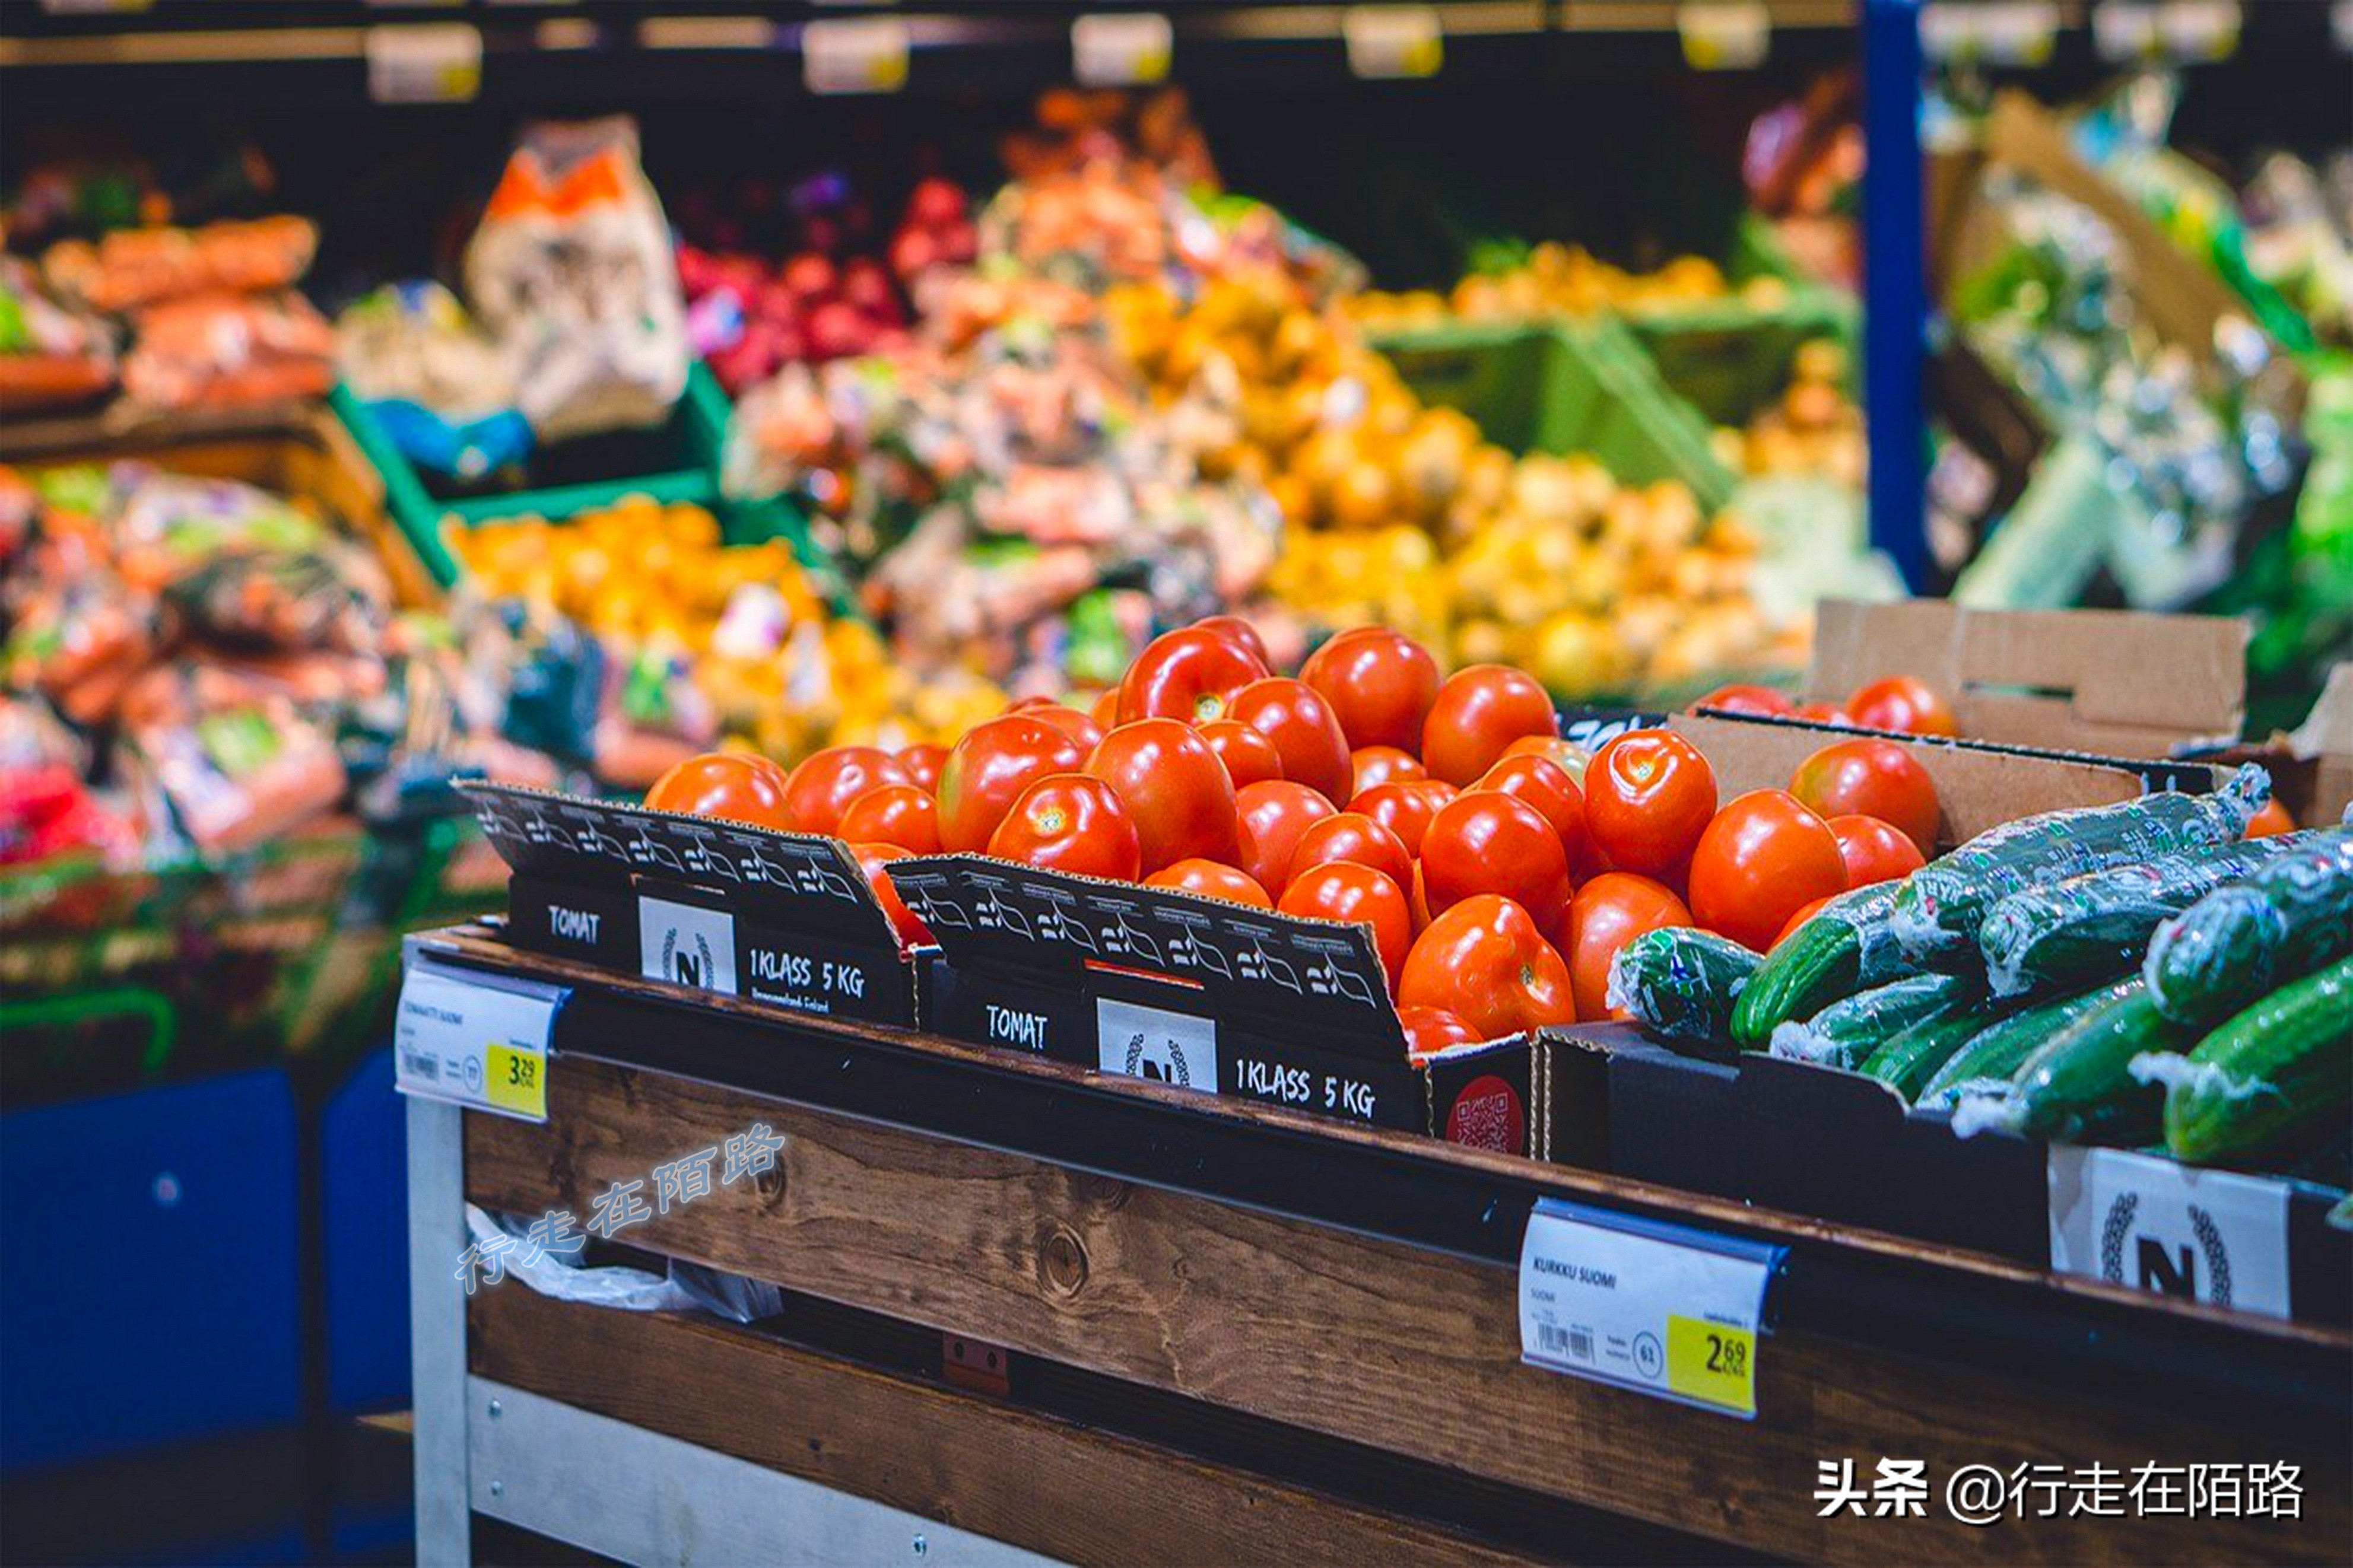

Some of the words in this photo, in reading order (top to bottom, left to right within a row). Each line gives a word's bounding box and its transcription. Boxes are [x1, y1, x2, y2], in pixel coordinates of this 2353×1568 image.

[548, 905, 601, 944] TOMAT
[676, 951, 699, 987] N
[823, 962, 833, 991] 5
[838, 964, 865, 998] KG
[986, 1005, 1047, 1049] TOMAT
[1325, 1077, 1337, 1108] 5
[1343, 1079, 1376, 1118] KG
[1533, 1254, 1577, 1280] KURKKU
[1579, 1266, 1617, 1289] SUOMI
[2137, 1237, 2195, 1303] N
